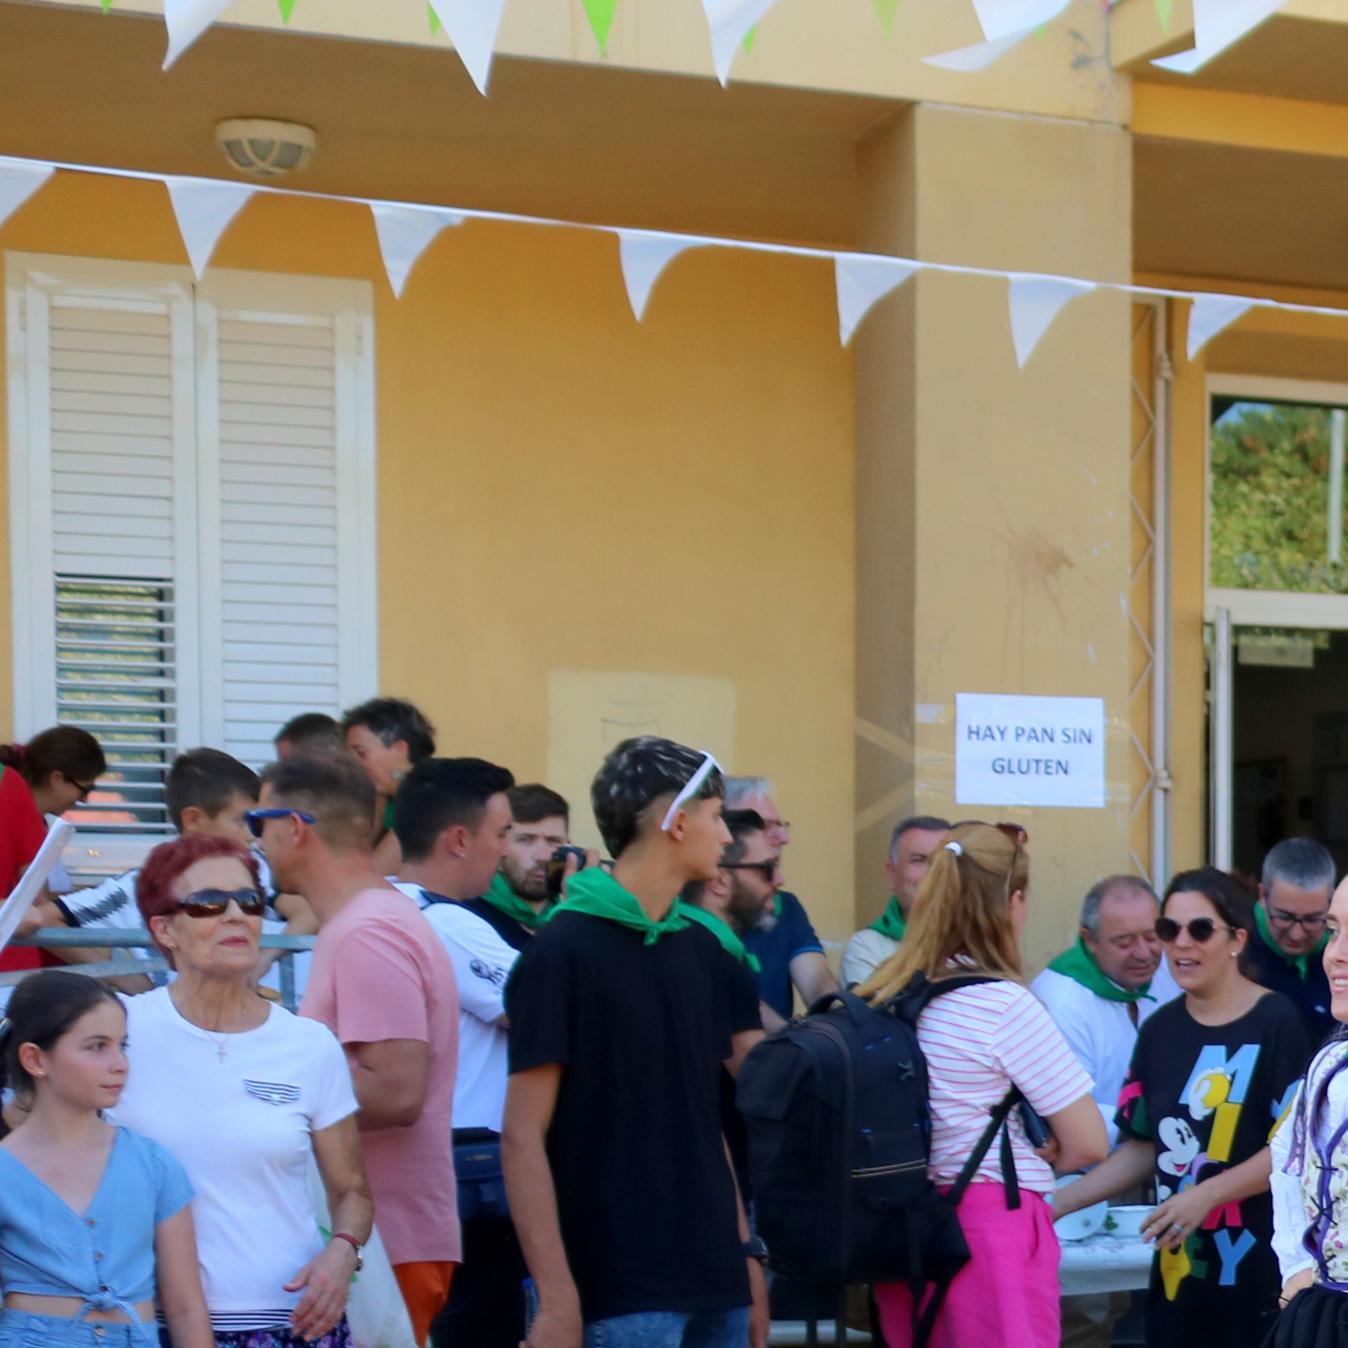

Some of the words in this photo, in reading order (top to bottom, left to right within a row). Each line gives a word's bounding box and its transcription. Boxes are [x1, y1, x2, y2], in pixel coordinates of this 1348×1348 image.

[966, 724, 1008, 742] HAY
[1014, 725, 1056, 744] PAN
[1061, 727, 1093, 745] SIN
[991, 757, 1070, 776] GLUTEN
